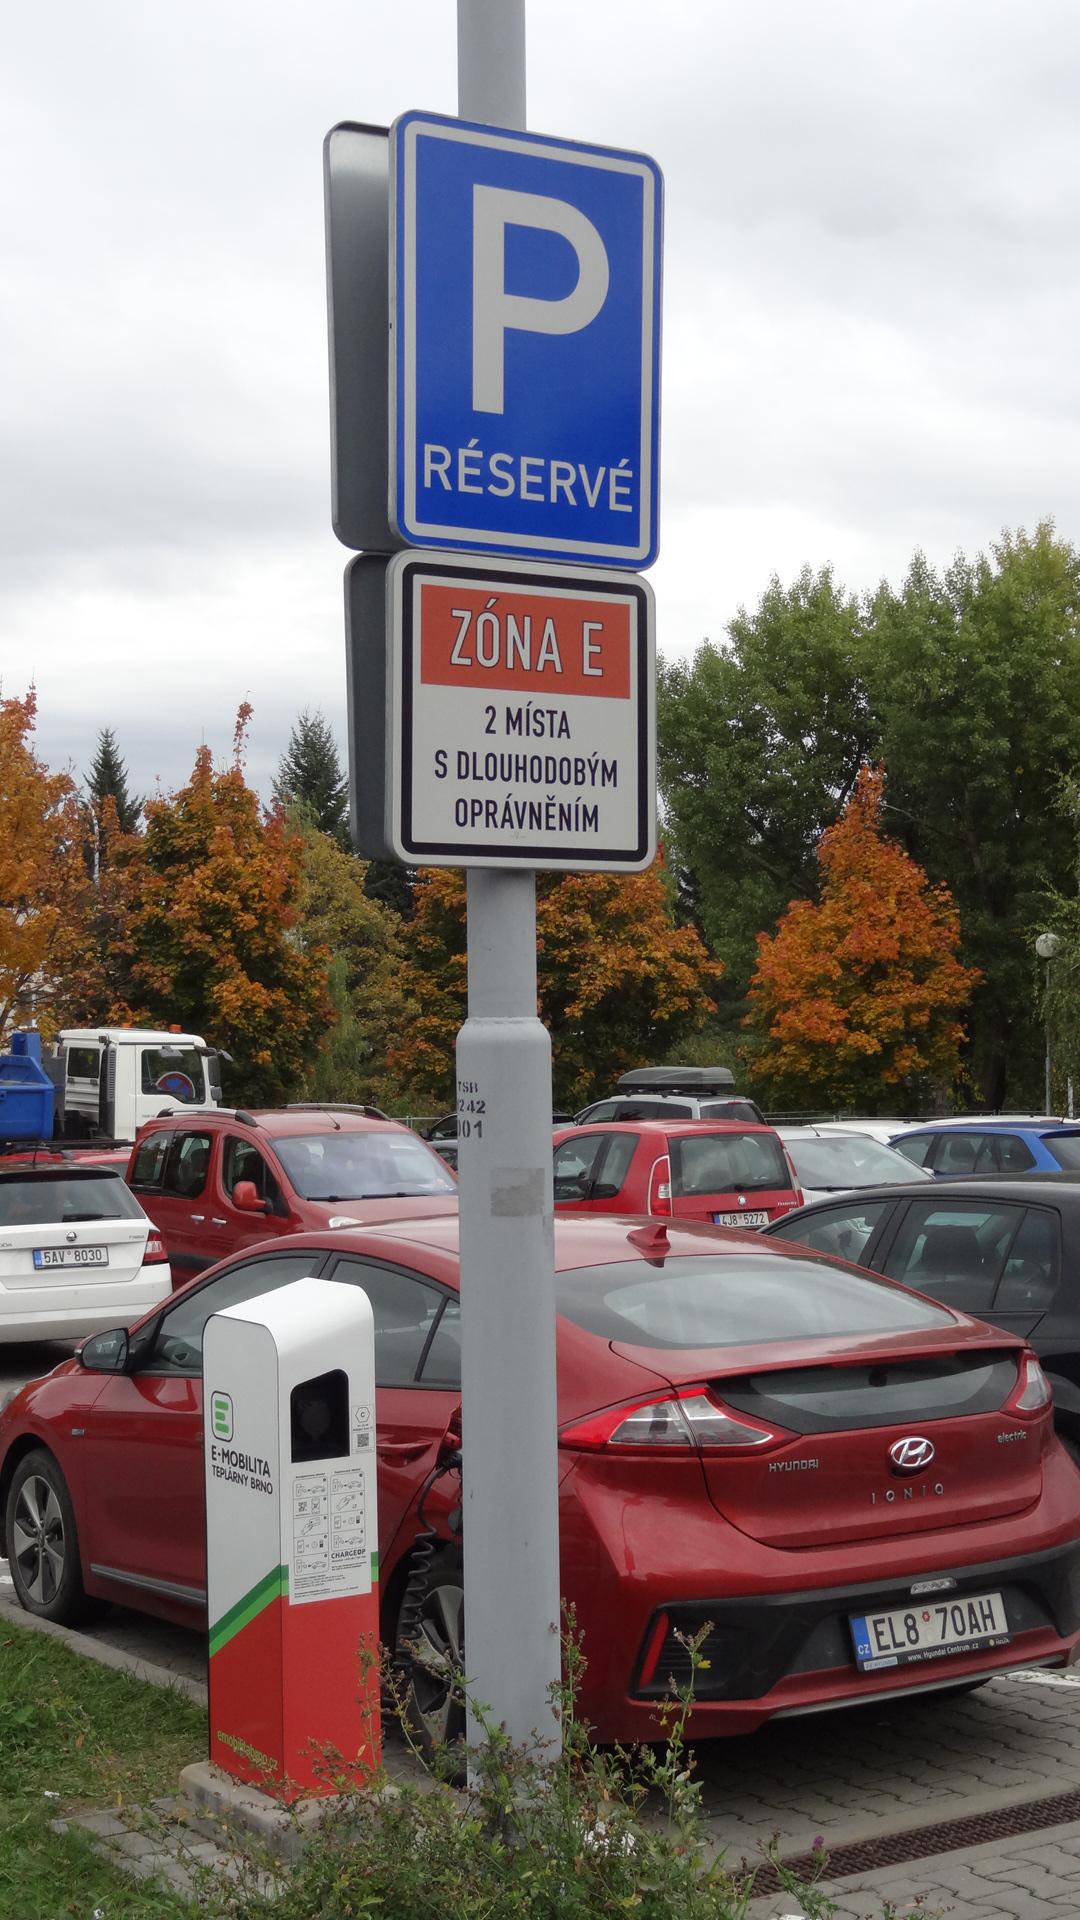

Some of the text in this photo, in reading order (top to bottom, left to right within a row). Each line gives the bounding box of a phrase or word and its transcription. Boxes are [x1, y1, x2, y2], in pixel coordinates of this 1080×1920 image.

[472, 184, 610, 415] P
[423, 438, 634, 512] RÉSERVÉ
[450, 597, 604, 677] ZÓNA E
[485, 701, 571, 739] 2 MÍSTA
[434, 750, 618, 787] S DLOUHODOBÝM
[455, 793, 599, 833] OPRÁVNĚNÍM
[459, 1099, 486, 1113] 242
[722, 1213, 765, 1226] 4J8 5272
[44, 1248, 102, 1264] 5AV 8030
[997, 1429, 1027, 1443] electric
[211, 1464, 273, 1495] TEPLÁRNY BRNO
[768, 1458, 819, 1473] HYUNDAI
[870, 1483, 945, 1504] IONIQ
[872, 1599, 997, 1652] EL8 70AH
[857, 1643, 871, 1655] CZ
